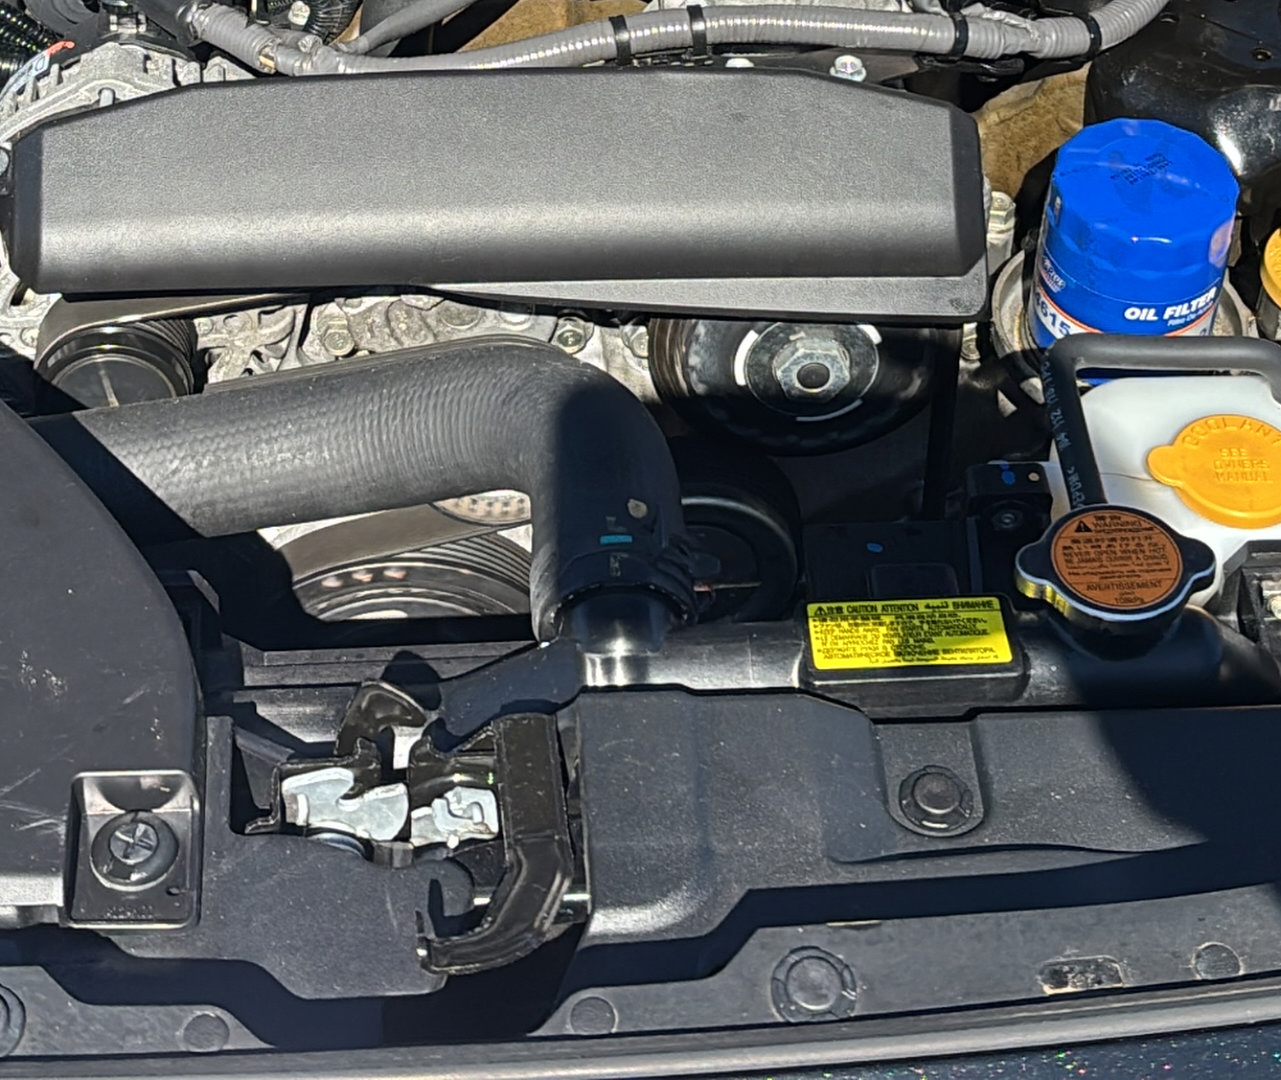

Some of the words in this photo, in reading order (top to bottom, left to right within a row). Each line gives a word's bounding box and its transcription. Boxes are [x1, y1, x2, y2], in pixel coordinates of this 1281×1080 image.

[1123, 307, 1159, 321] OIL
[1163, 287, 1217, 320] FILTER
[1220, 448, 1248, 460] SEE
[1085, 581, 1162, 591] AVERTISSEMENT
[846, 604, 877, 613] CAUTION
[880, 603, 918, 612] ATTENTION
